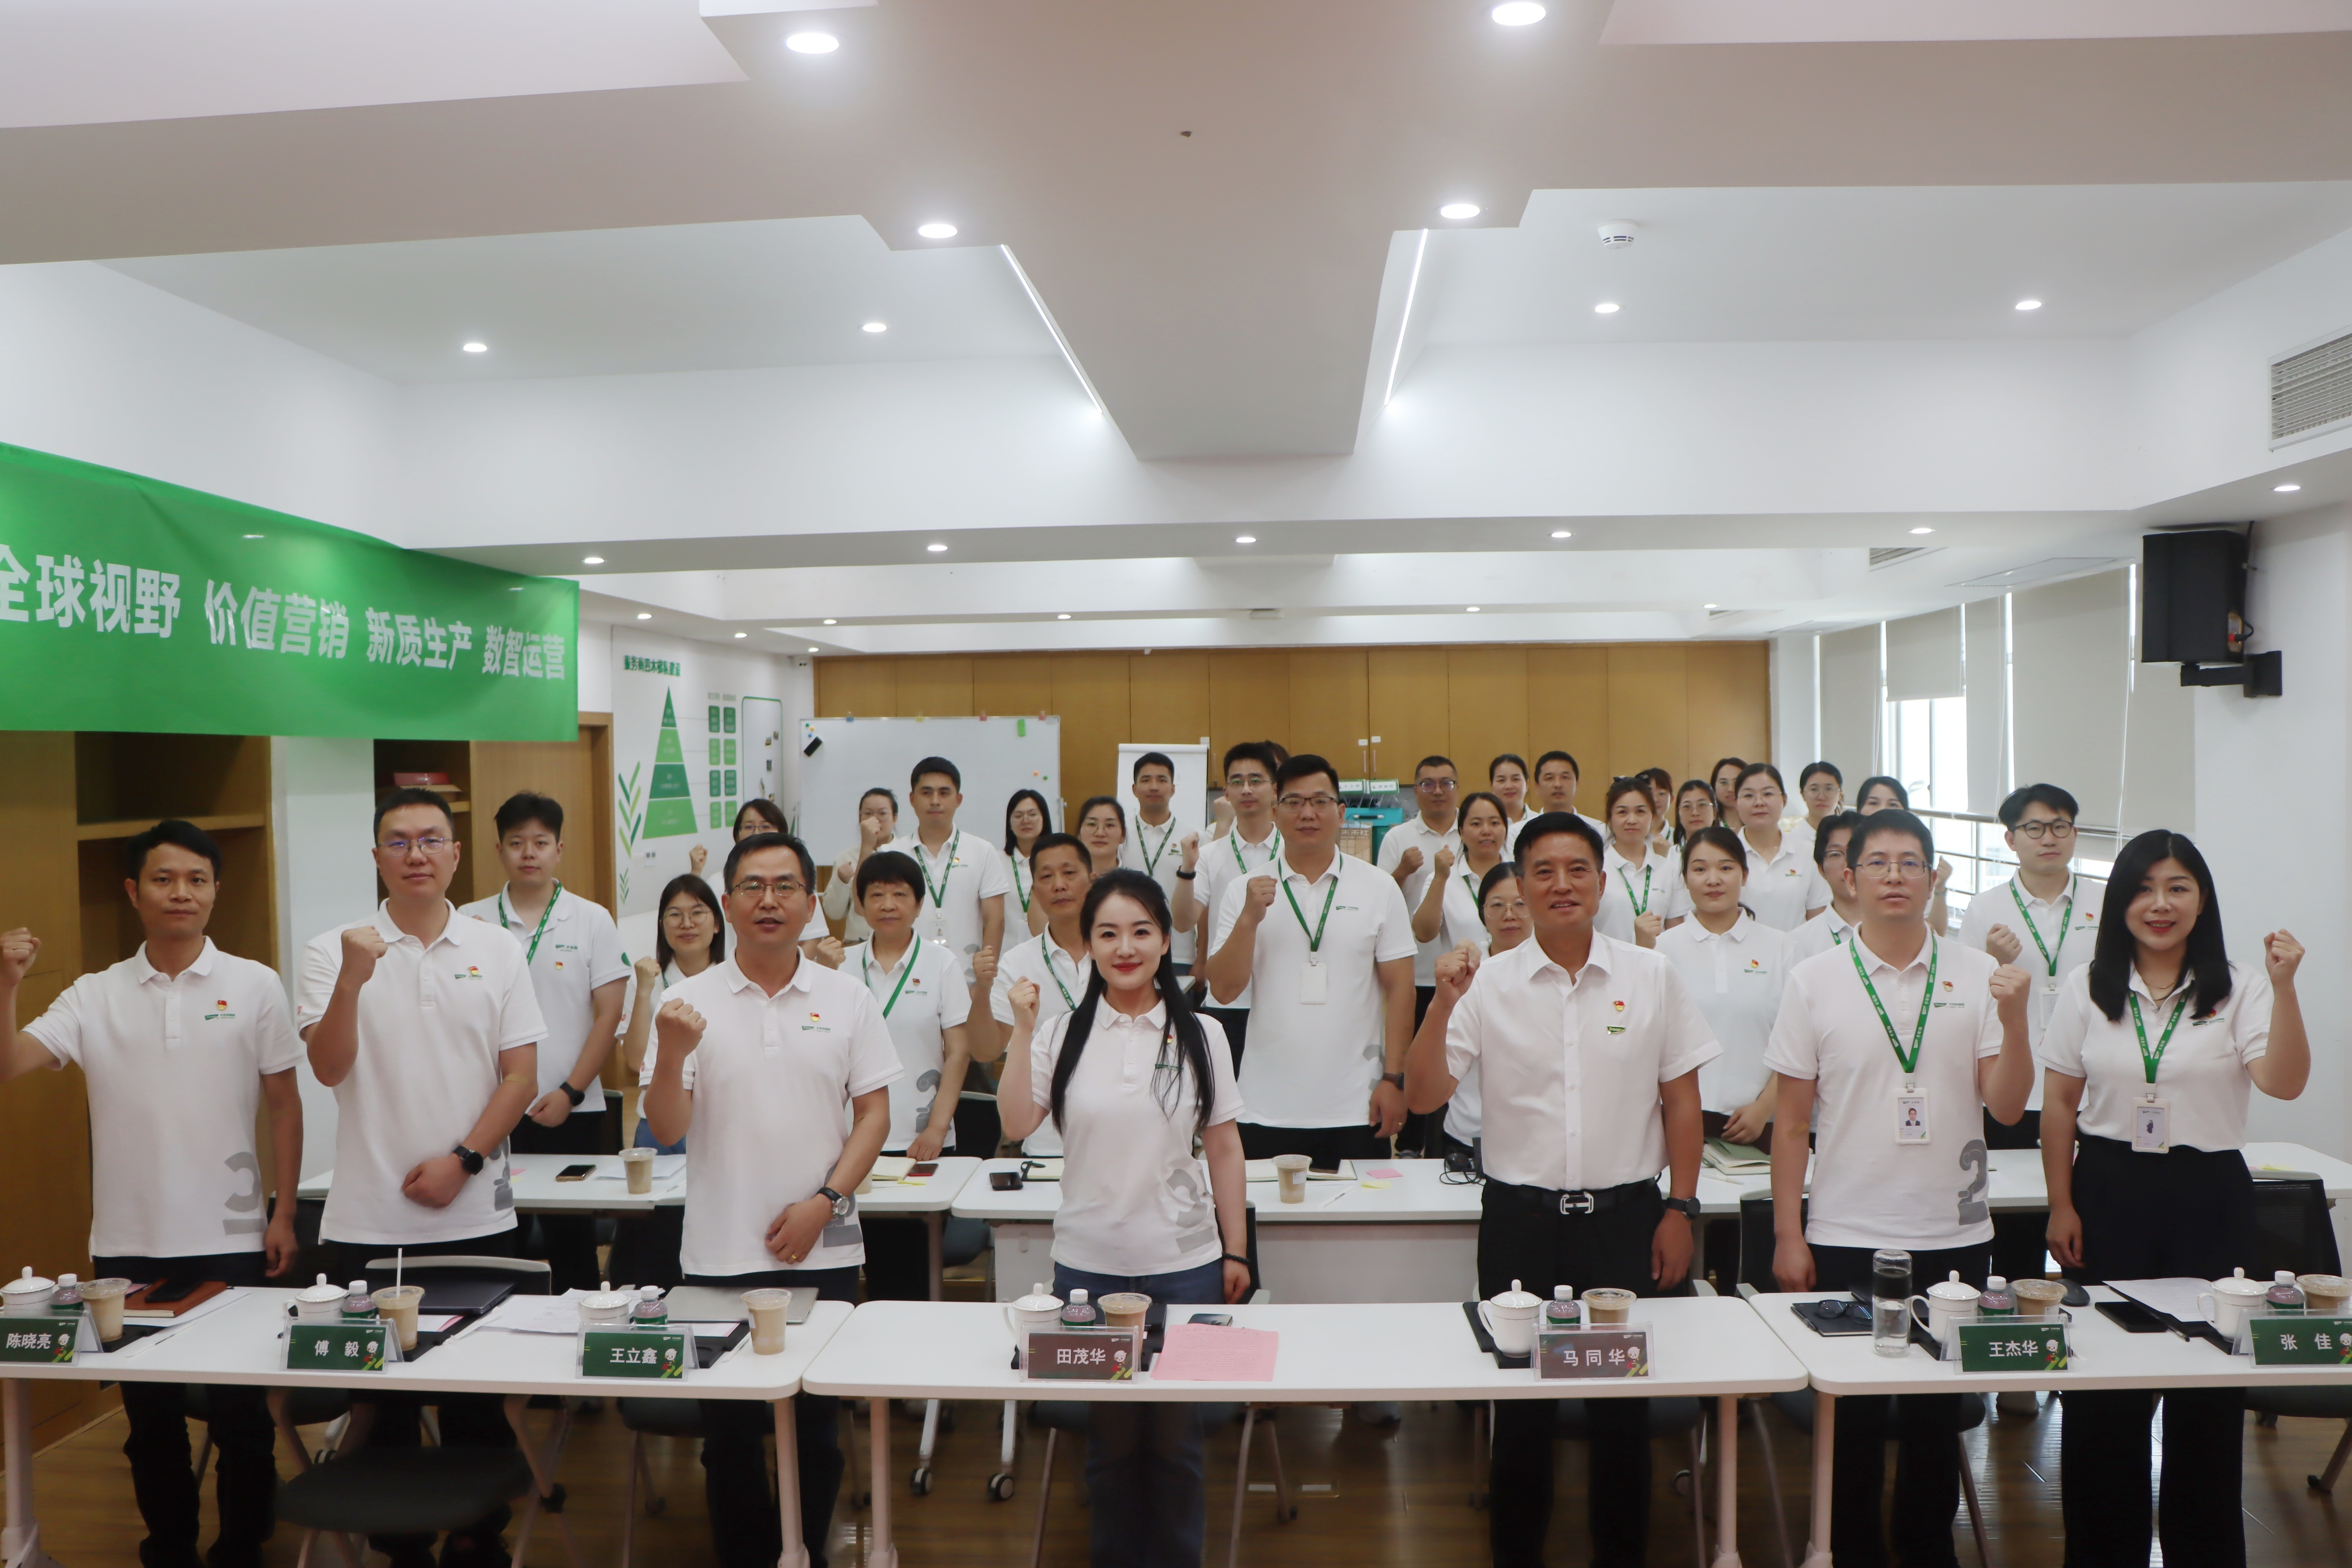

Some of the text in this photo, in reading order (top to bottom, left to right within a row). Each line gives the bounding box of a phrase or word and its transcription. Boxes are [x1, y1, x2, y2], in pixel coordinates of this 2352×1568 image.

[0, 544, 565, 680] 全球视野 价值营销 新质生产 数智运营
[6, 1333, 51, 1349] 陈晓亮
[315, 1340, 359, 1357] 傅毅
[1989, 1340, 2038, 1357] 王杰华
[2280, 1333, 2332, 1350] 张佳
[610, 1348, 658, 1364] 王立鑫
[1057, 1348, 1106, 1365] 田茂华
[1563, 1348, 1625, 1366] 马同华
